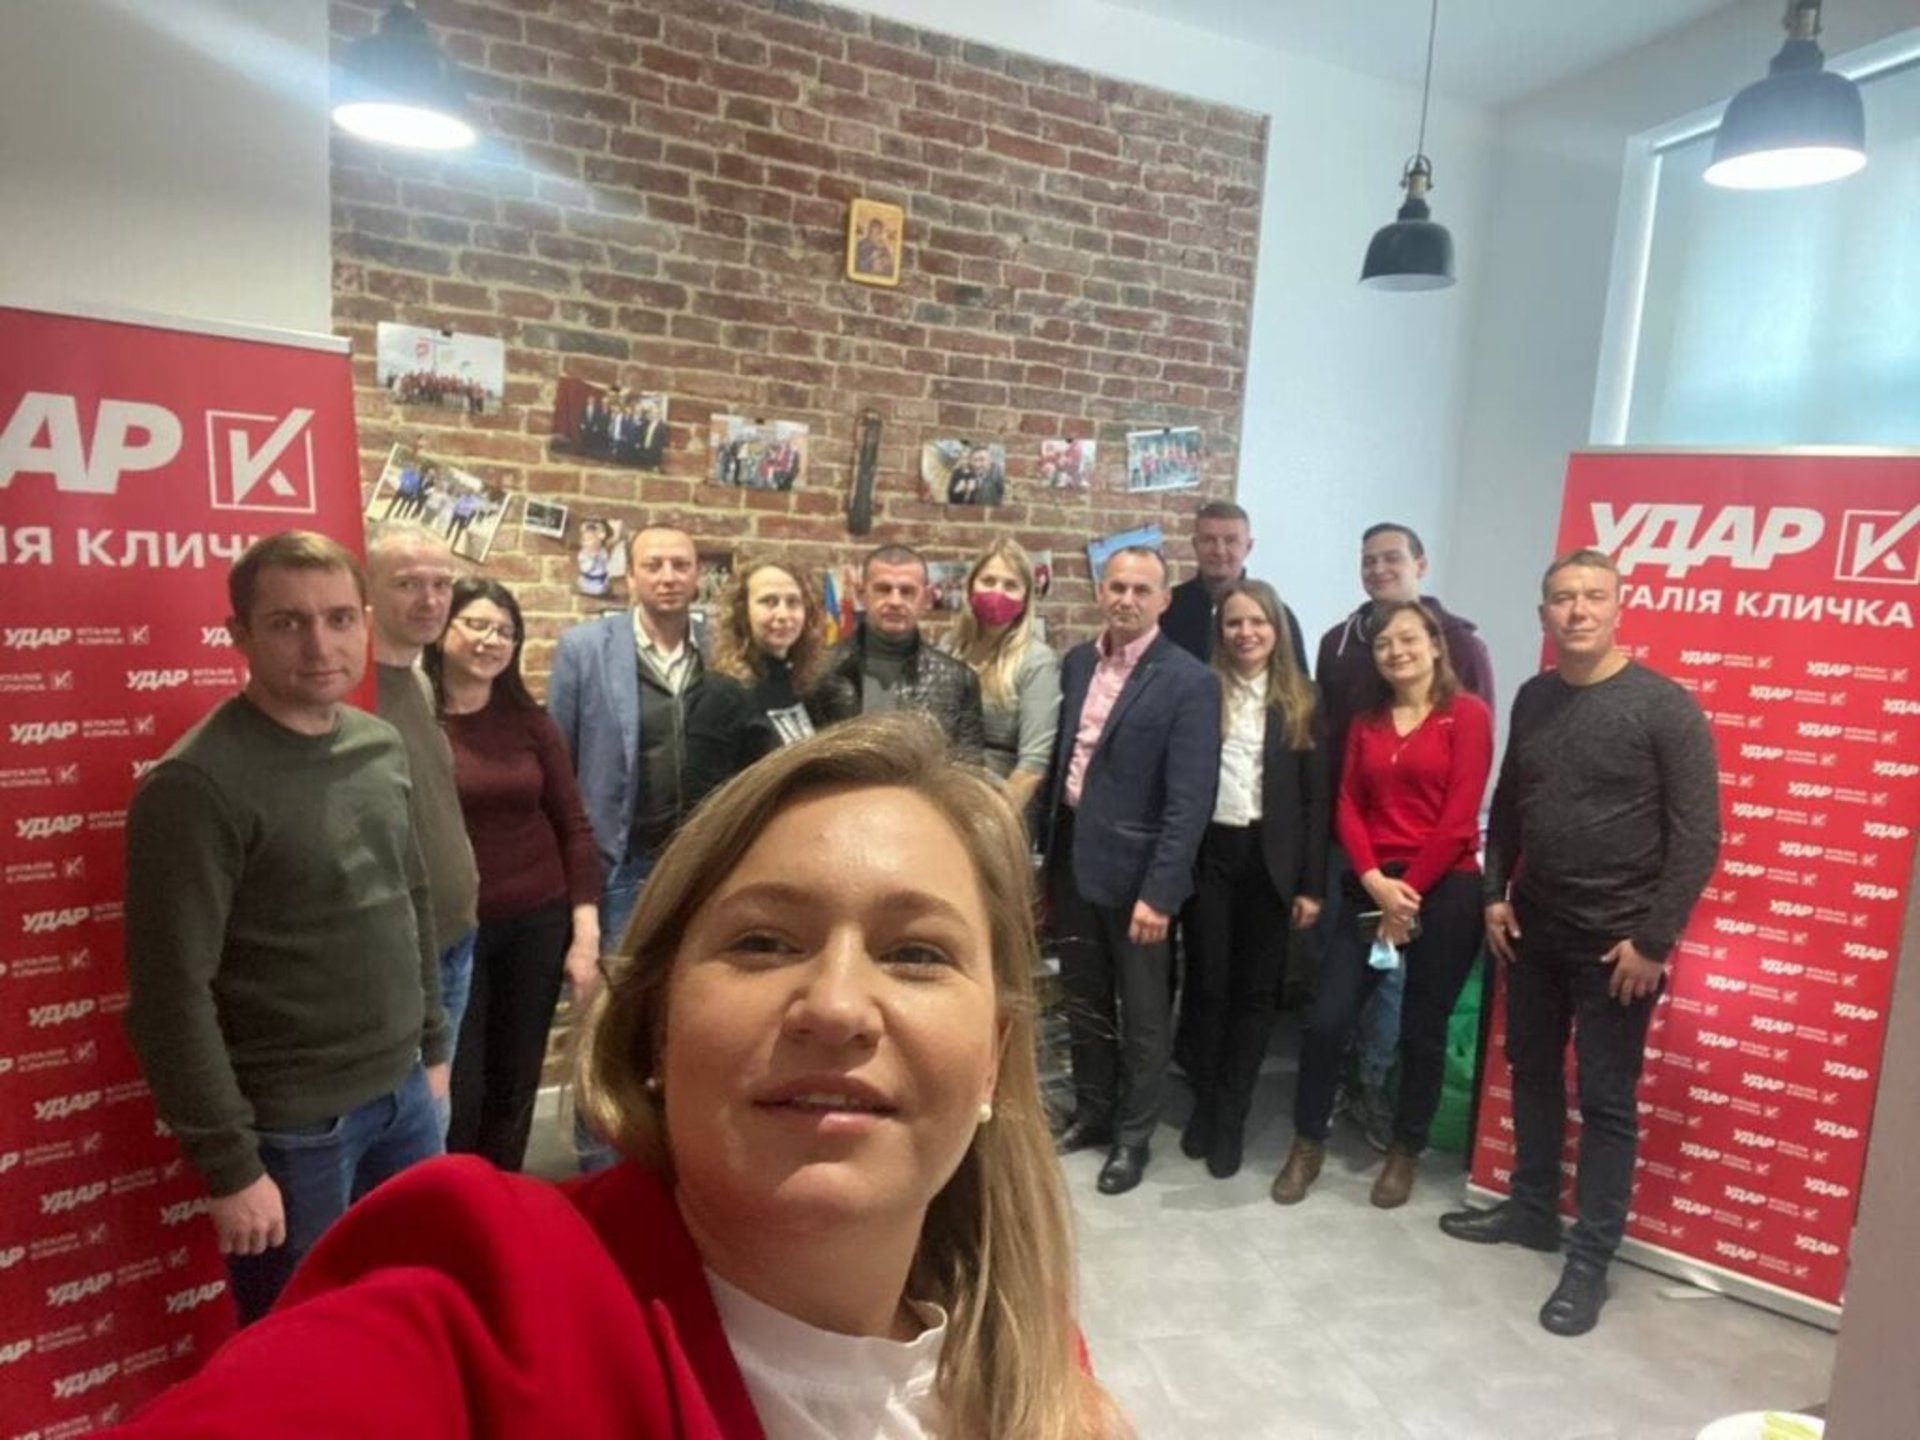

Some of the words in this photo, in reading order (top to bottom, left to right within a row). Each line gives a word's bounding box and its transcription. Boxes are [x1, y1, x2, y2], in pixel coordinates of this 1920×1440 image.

[0, 391, 183, 494] АР
[0, 527, 53, 564] ІЯ
[1586, 502, 1825, 578] УДАР
[1619, 584, 1722, 614] ТАЛІЯ
[1735, 591, 1914, 628] КЛИЧКА
[4, 627, 71, 649] УДАР
[127, 668, 189, 690] УДАР
[10, 721, 77, 744] УДАР
[16, 814, 83, 839] УДАР
[22, 907, 89, 933] УДАР
